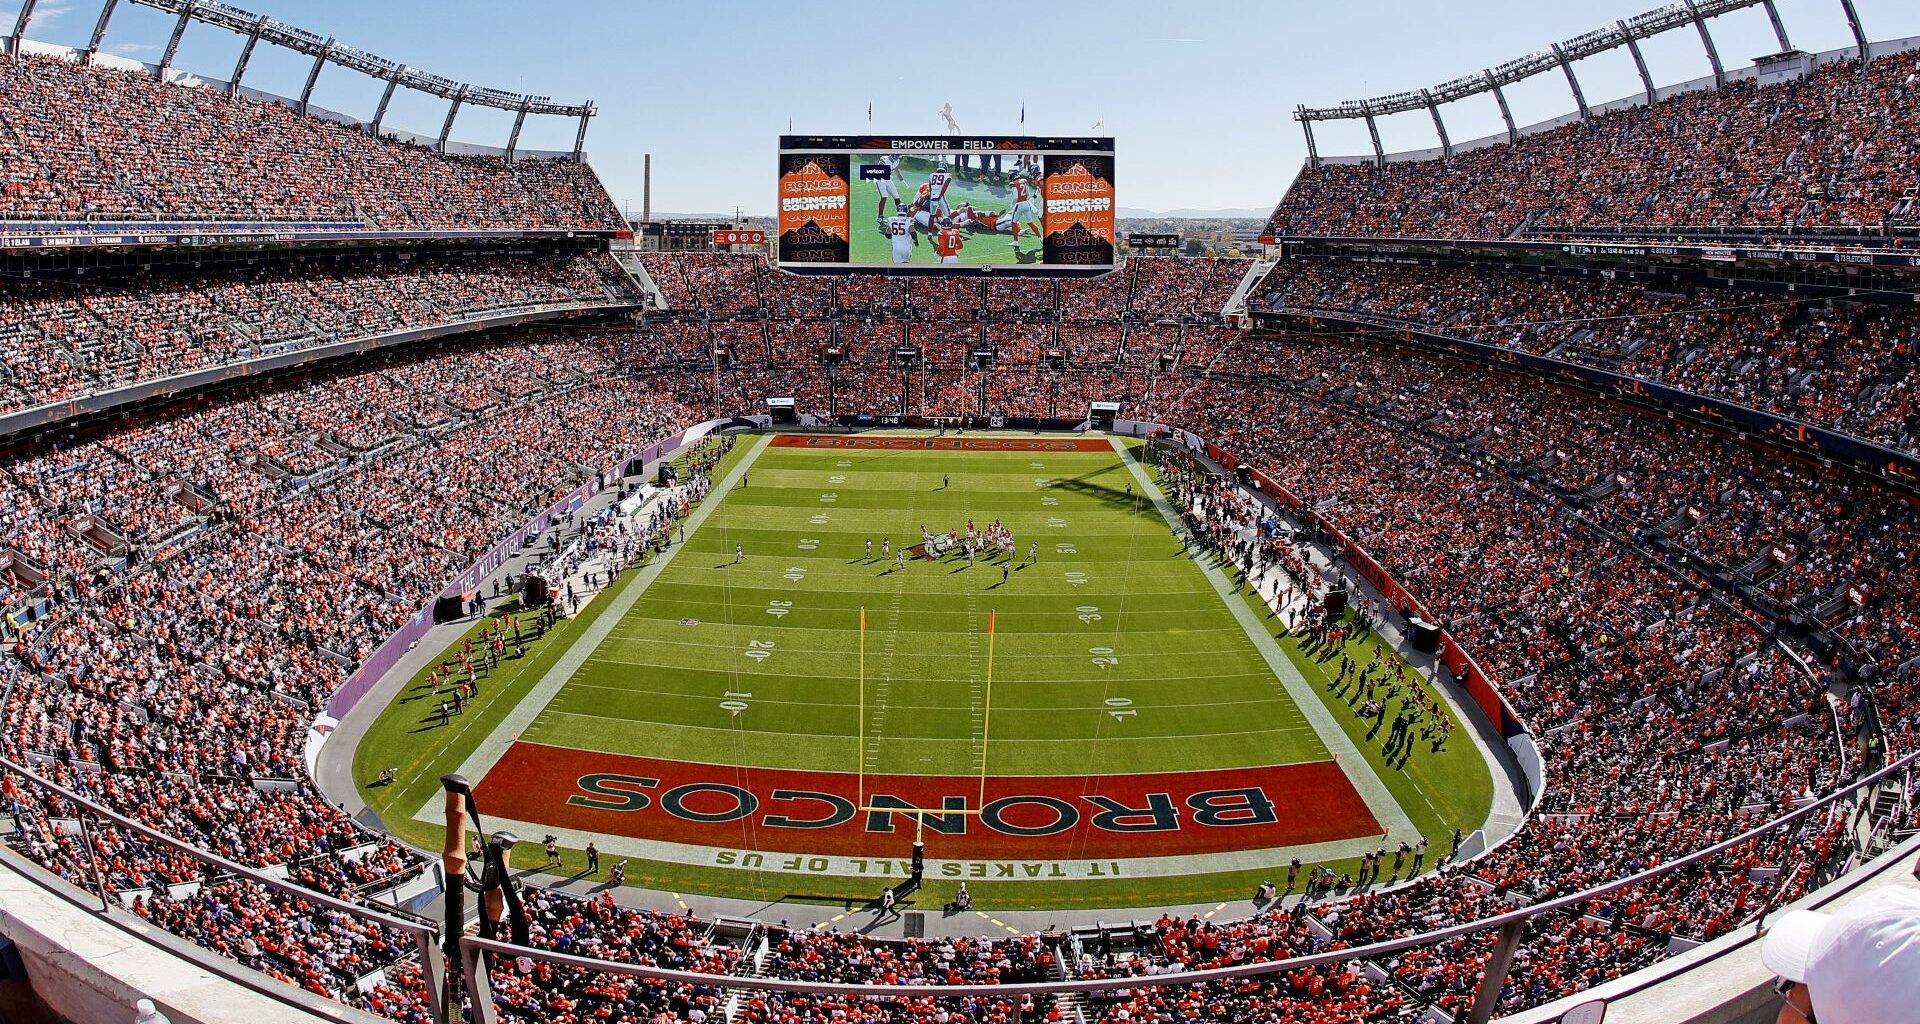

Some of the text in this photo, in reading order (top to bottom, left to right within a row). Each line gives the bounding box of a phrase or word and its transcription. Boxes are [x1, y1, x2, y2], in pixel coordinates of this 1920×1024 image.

[891, 140, 995, 149] EMPOWER FIELD
[931, 175, 944, 186] 89
[783, 195, 847, 205] BRONCOS
[1047, 198, 1111, 207] BRONCOS
[783, 201, 847, 212] COUNTRY
[1047, 204, 1111, 214] COUNTRY
[891, 222, 906, 236] 65
[15, 238, 30, 246] ELAM
[219, 236, 224, 244] 0
[948, 236, 955, 248] 0
[1757, 251, 1778, 259] MANNING
[1799, 253, 1817, 261] MILLER
[1845, 255, 1871, 263] FLETCHER
[880, 416, 898, 425] 13:48
[807, 438, 1077, 449] BRONCOS
[797, 538, 820, 550] 50
[1056, 543, 1078, 554] 50
[459, 573, 476, 594] THE
[479, 553, 499, 581] MILE
[500, 536, 520, 563] HIGH
[1346, 546, 1387, 590] BRONCOS
[783, 566, 807, 580] 40
[1064, 571, 1088, 584] 40
[765, 600, 793, 615] 30
[1075, 606, 1102, 621] 30
[745, 639, 776, 658] 20
[1088, 647, 1119, 665] 20
[719, 690, 752, 710] 10
[1104, 697, 1138, 717] 10
[565, 772, 1279, 838] BRONCOS
[716, 850, 1120, 879] IT TAKES ALL OF US
